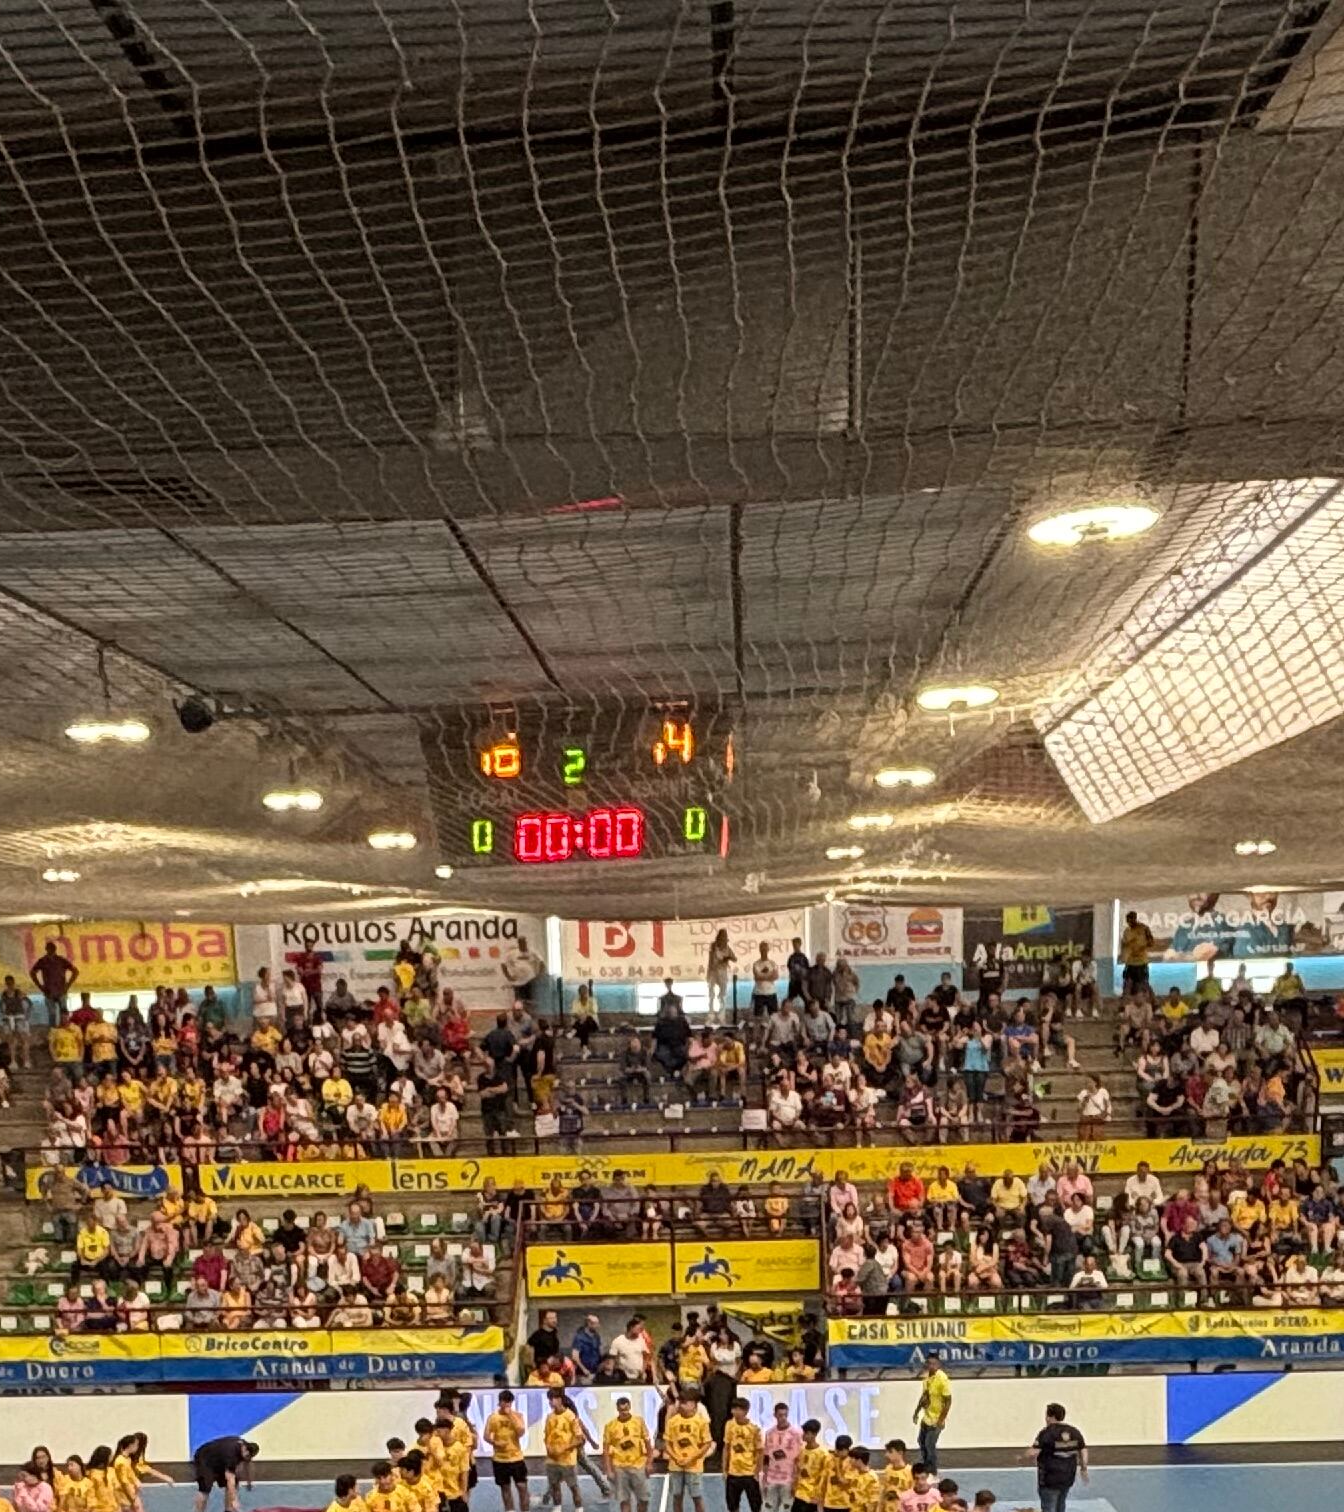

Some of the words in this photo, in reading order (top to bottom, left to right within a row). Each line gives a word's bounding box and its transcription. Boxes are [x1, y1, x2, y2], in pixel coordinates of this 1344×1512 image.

[563, 748, 585, 784] 2
[514, 808, 645, 861] 00:00
[684, 806, 704, 840] 0
[471, 819, 493, 853] 0
[407, 916, 519, 943] Aranda
[1168, 1141, 1274, 1167] Avenida
[1277, 1139, 1309, 1161] 73
[239, 1170, 347, 1192] VALCARCE
[847, 1322, 889, 1341] CASA
[896, 1320, 967, 1340] SILVIANO
[204, 1336, 310, 1351] BricoCentro
[1028, 1341, 1099, 1361] Duero
[1259, 1337, 1341, 1358] Aranda
[26, 1360, 95, 1380] Duero
[252, 1357, 328, 1378] Aranda
[367, 1355, 436, 1375] Duero
